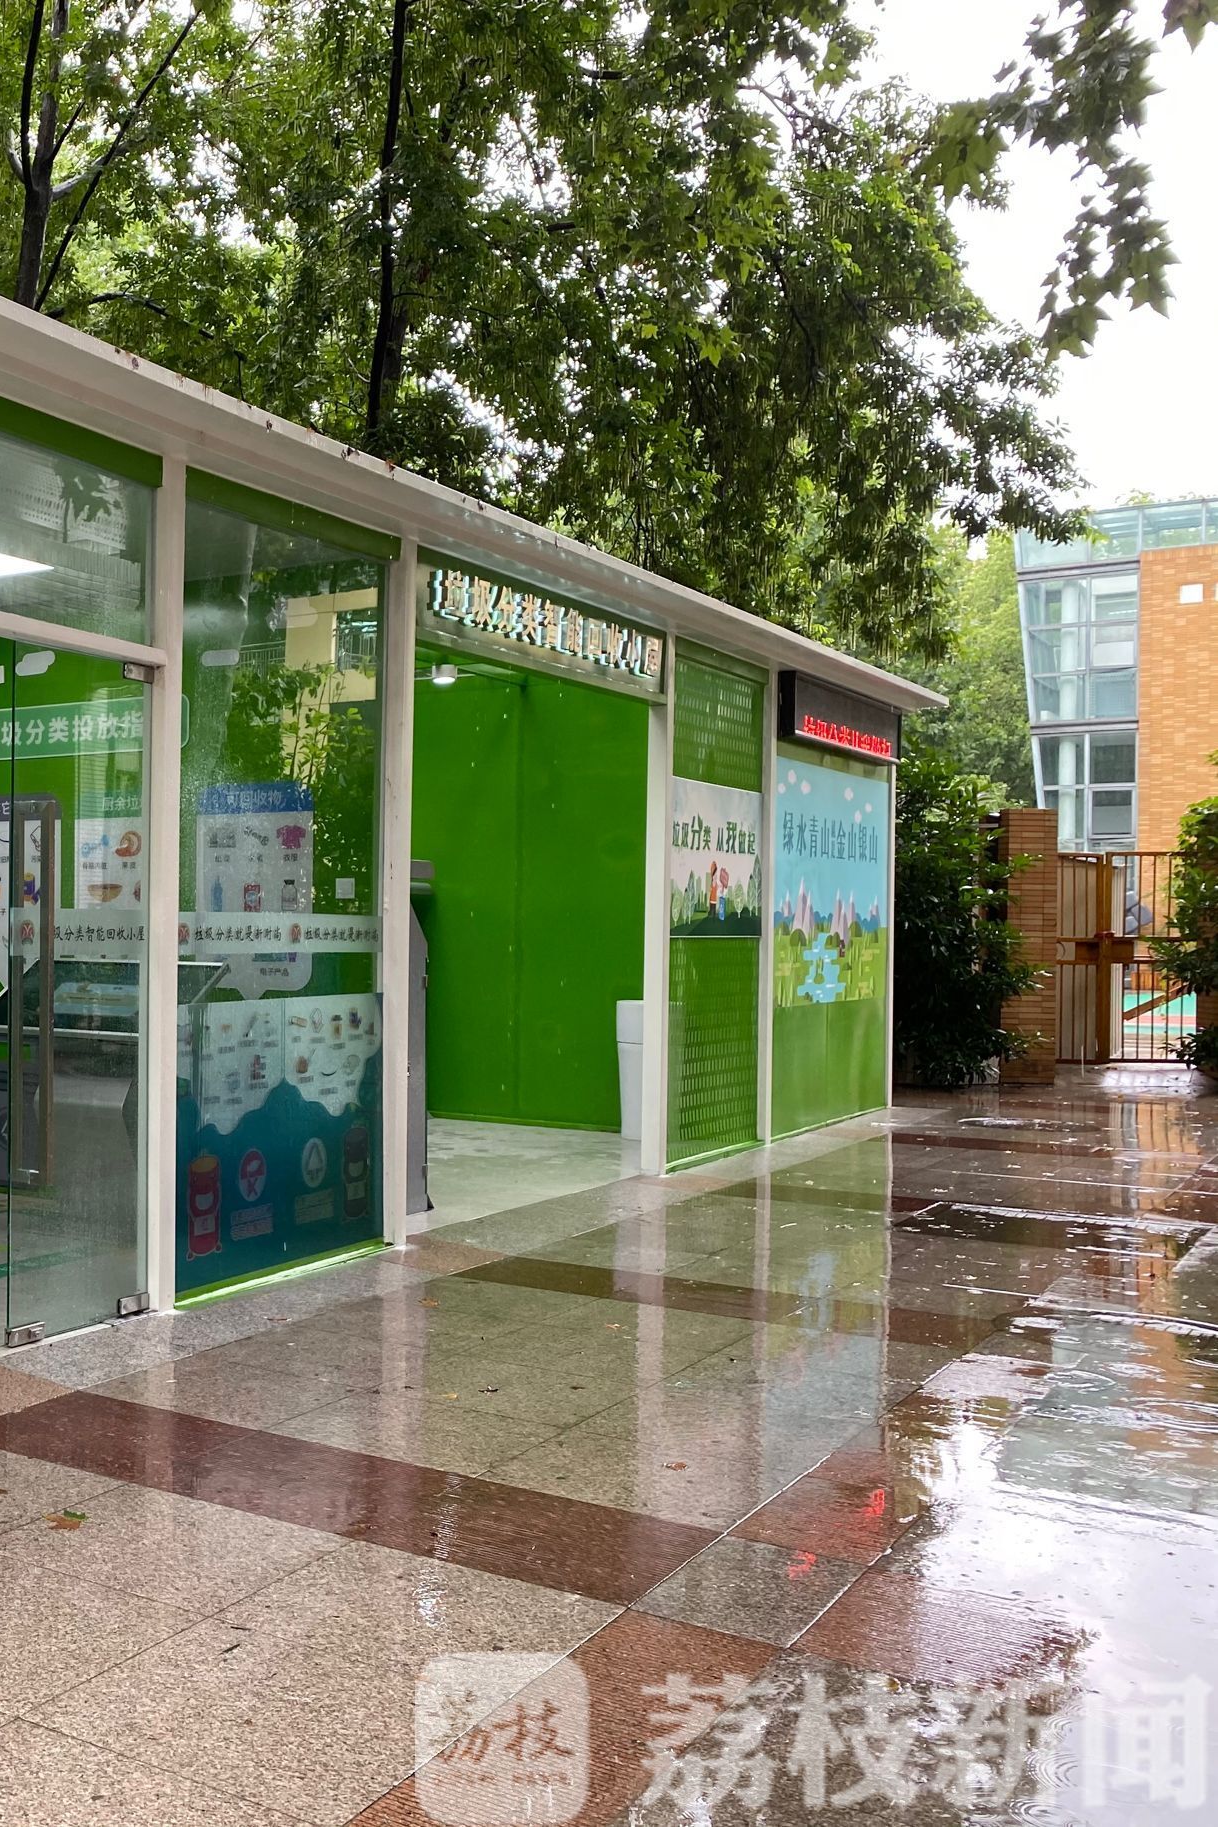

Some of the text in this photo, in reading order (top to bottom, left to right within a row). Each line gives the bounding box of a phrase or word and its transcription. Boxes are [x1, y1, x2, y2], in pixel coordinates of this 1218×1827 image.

[434, 568, 660, 679] 垃圾分类智能回收小屋
[671, 813, 712, 851] 垃圾分类
[715, 821, 756, 855] 从我做起
[193, 924, 283, 943] 垃圾分类就是新时尚
[304, 926, 379, 944] 垃圾分类就是新时尚
